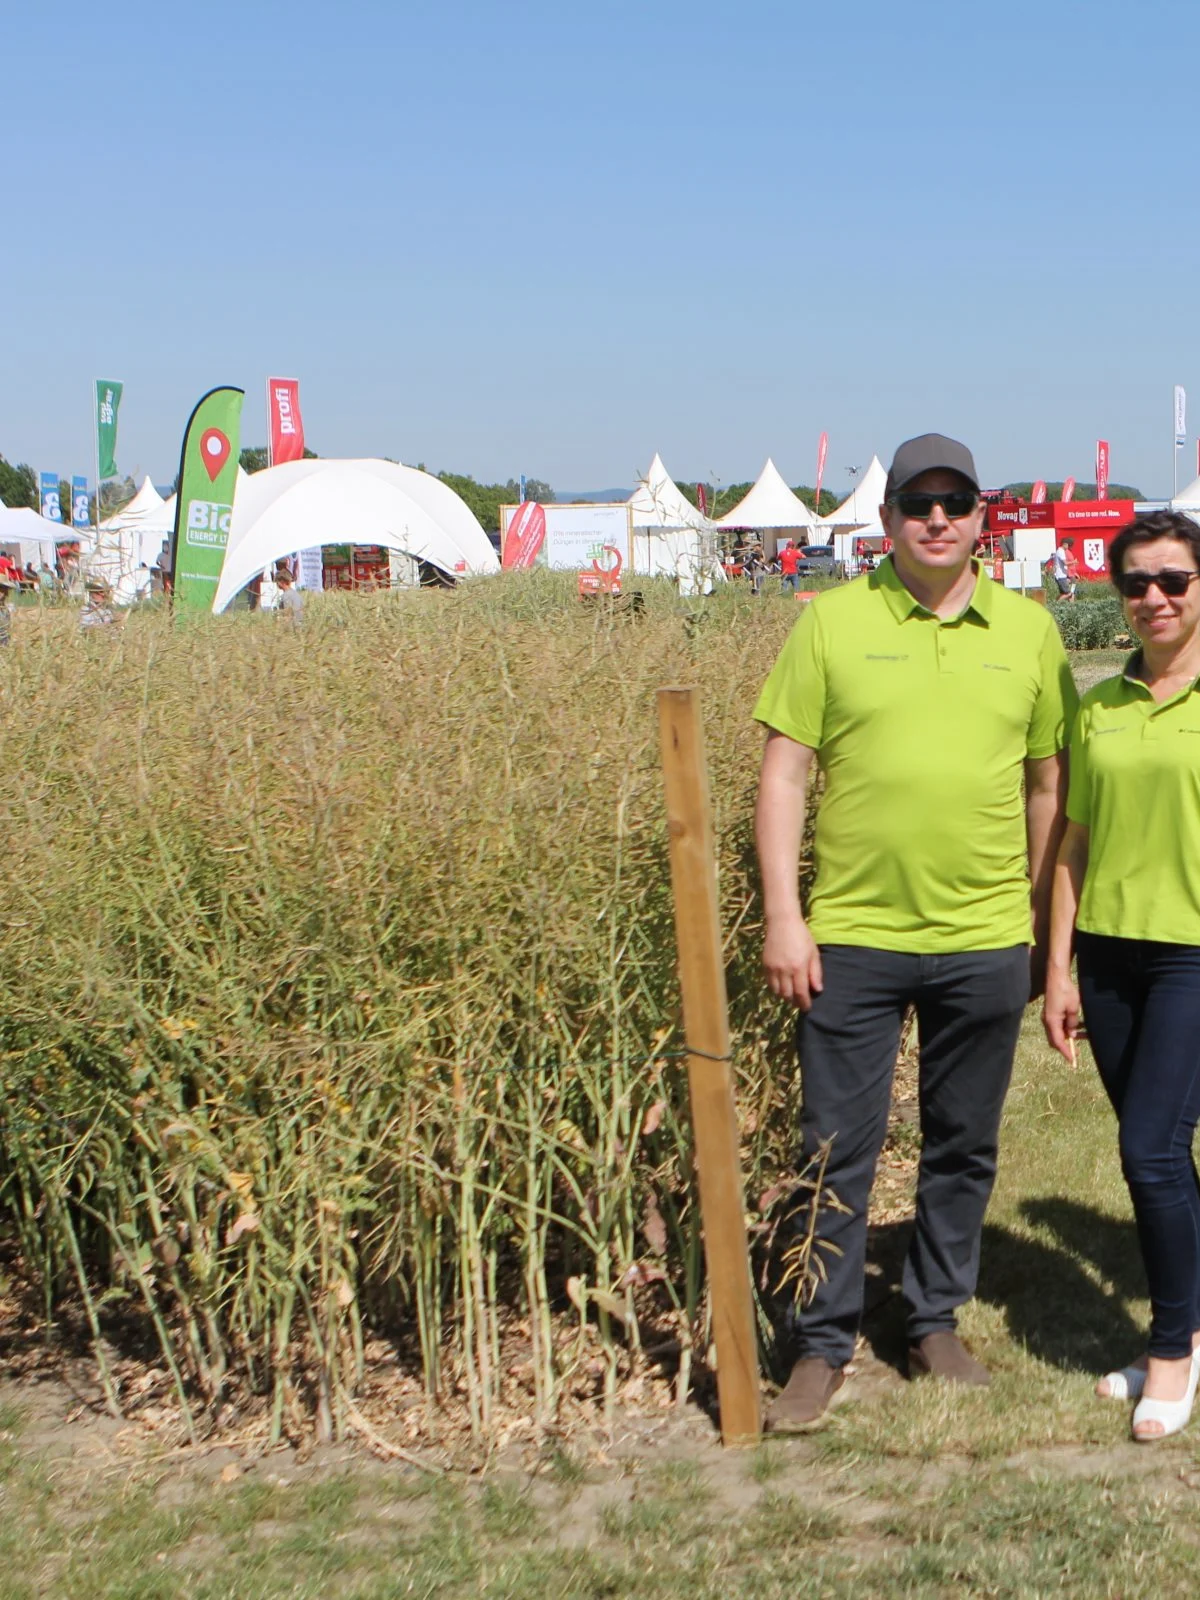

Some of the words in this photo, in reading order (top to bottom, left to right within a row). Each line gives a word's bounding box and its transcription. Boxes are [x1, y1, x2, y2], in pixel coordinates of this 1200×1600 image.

[275, 388, 295, 433] profi
[997, 511, 1018, 521] Novag
[190, 530, 217, 543] ENERGY
